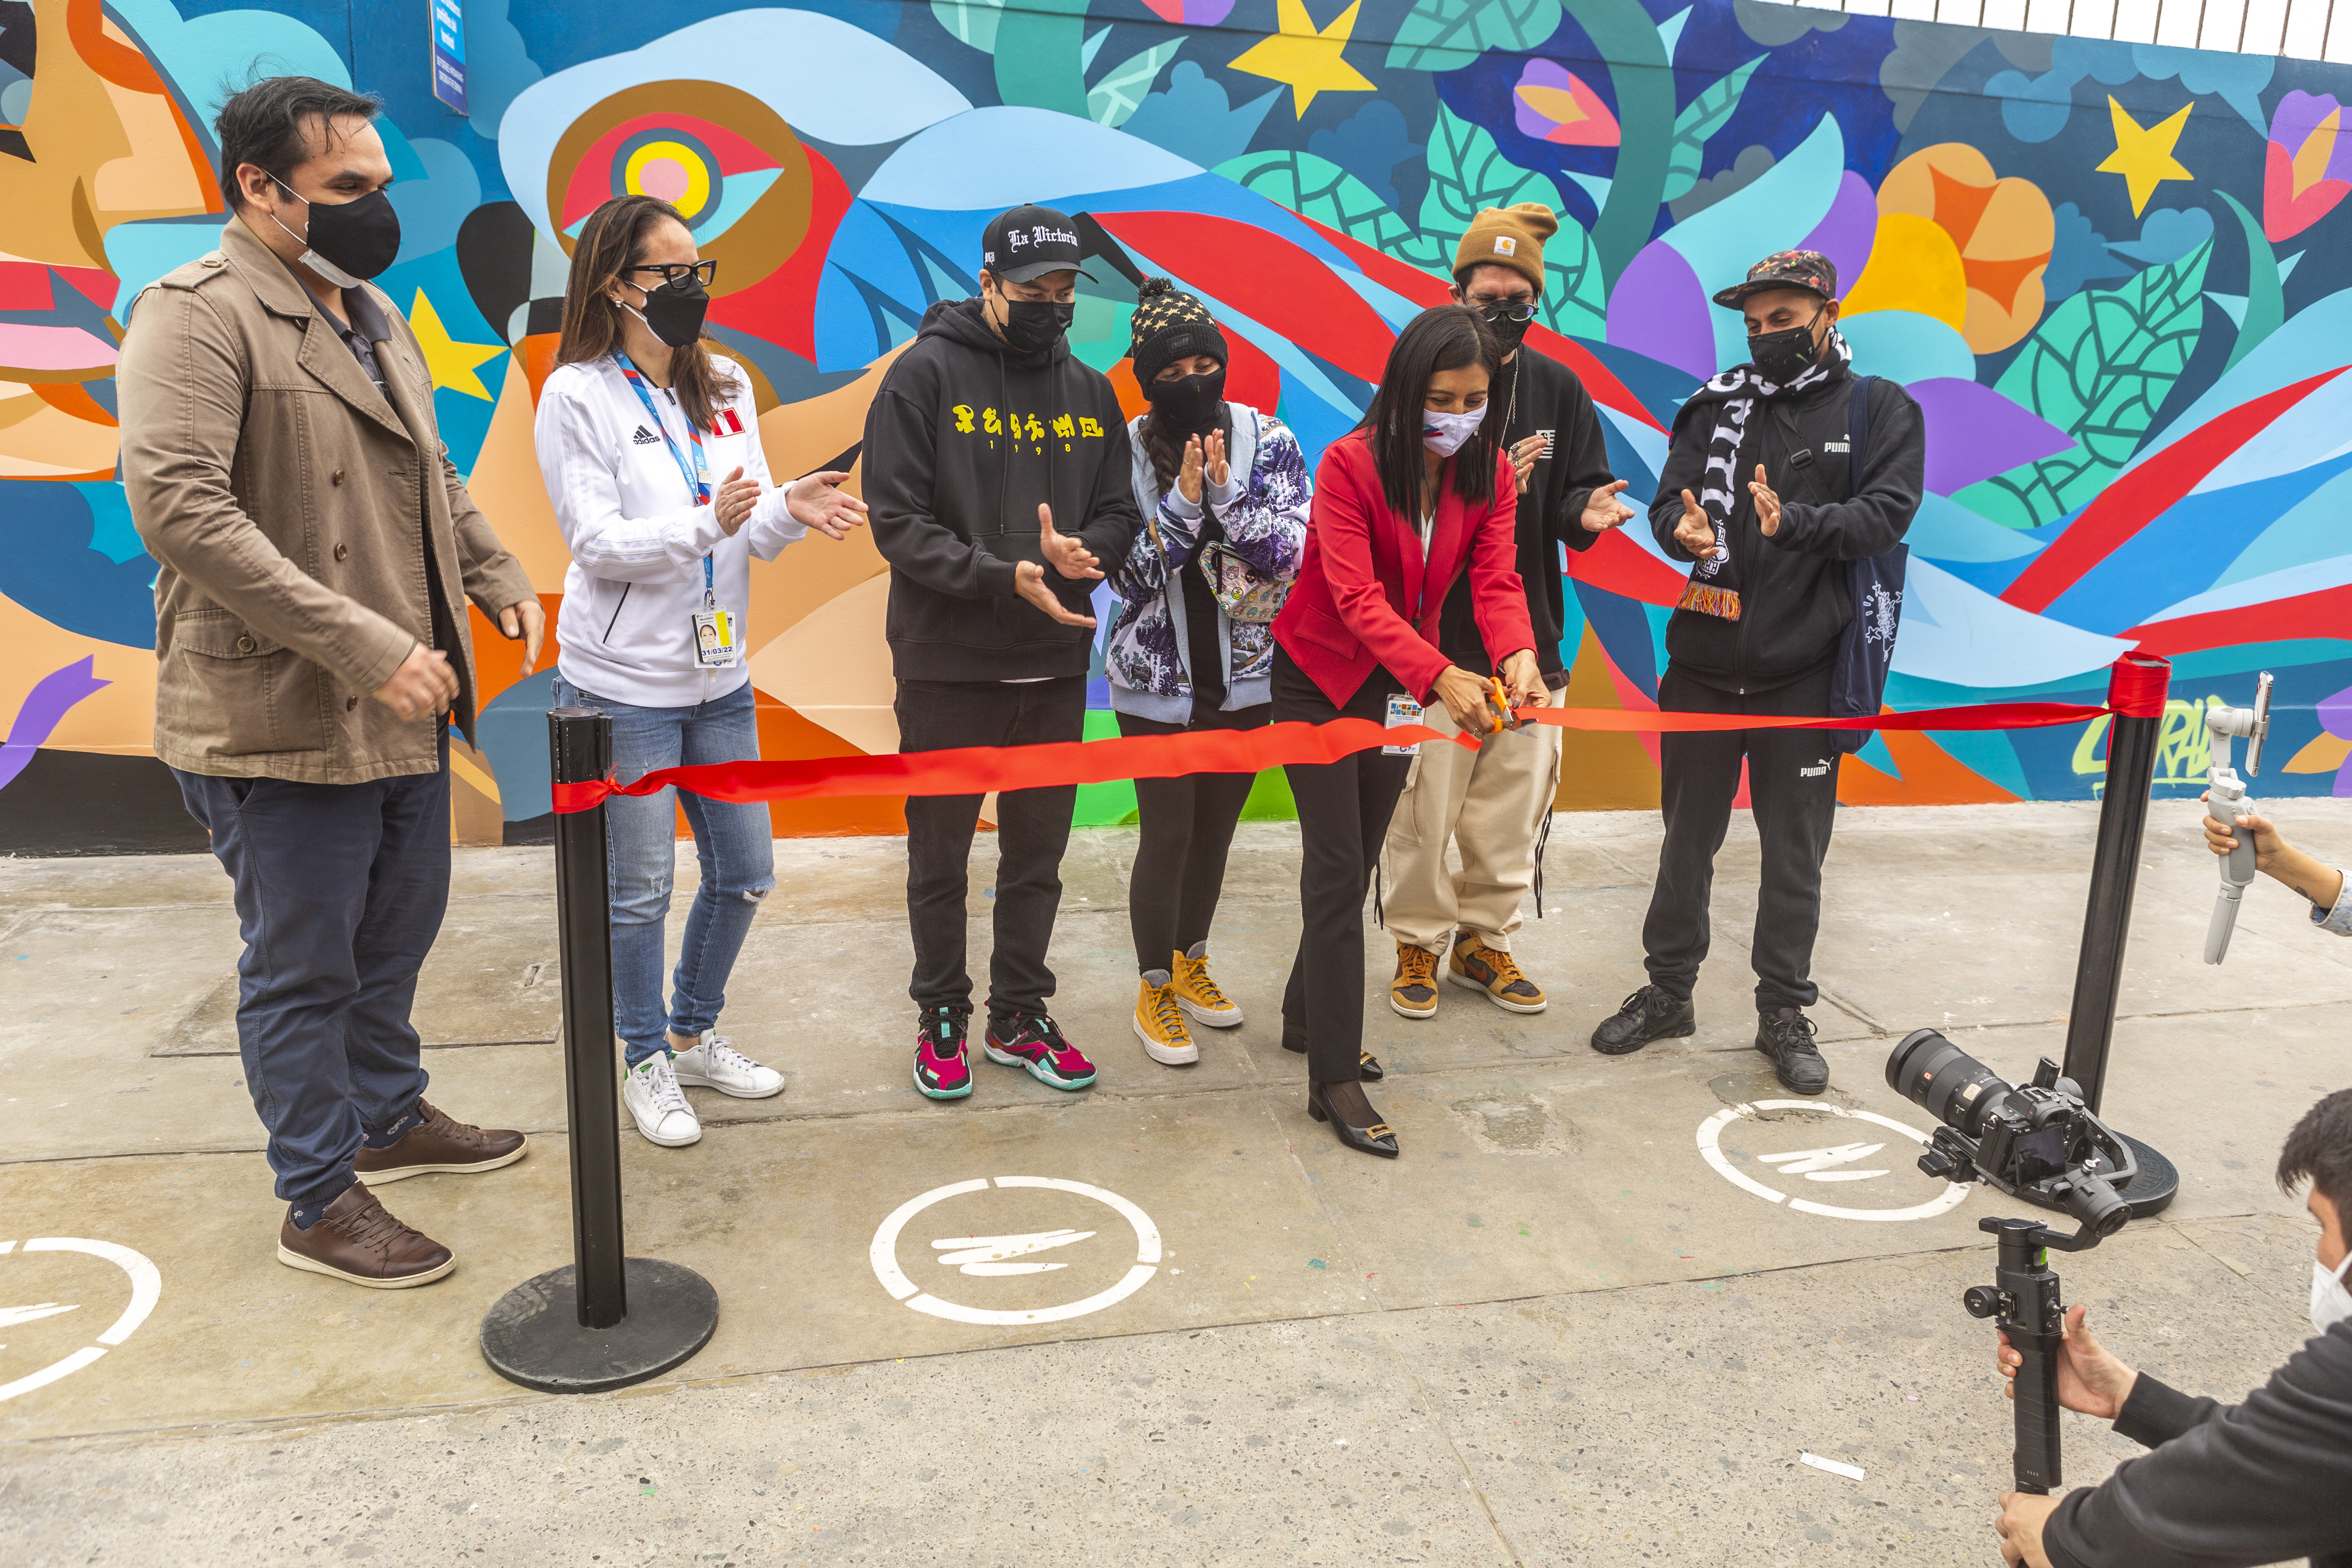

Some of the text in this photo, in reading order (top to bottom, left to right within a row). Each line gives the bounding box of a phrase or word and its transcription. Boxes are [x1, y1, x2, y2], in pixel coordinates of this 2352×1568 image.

[1008, 225, 1078, 253] La Victoria
[633, 436, 660, 445] adidas
[702, 646, 733, 656] 31/03/22
[1800, 766, 1827, 777] PUMA
